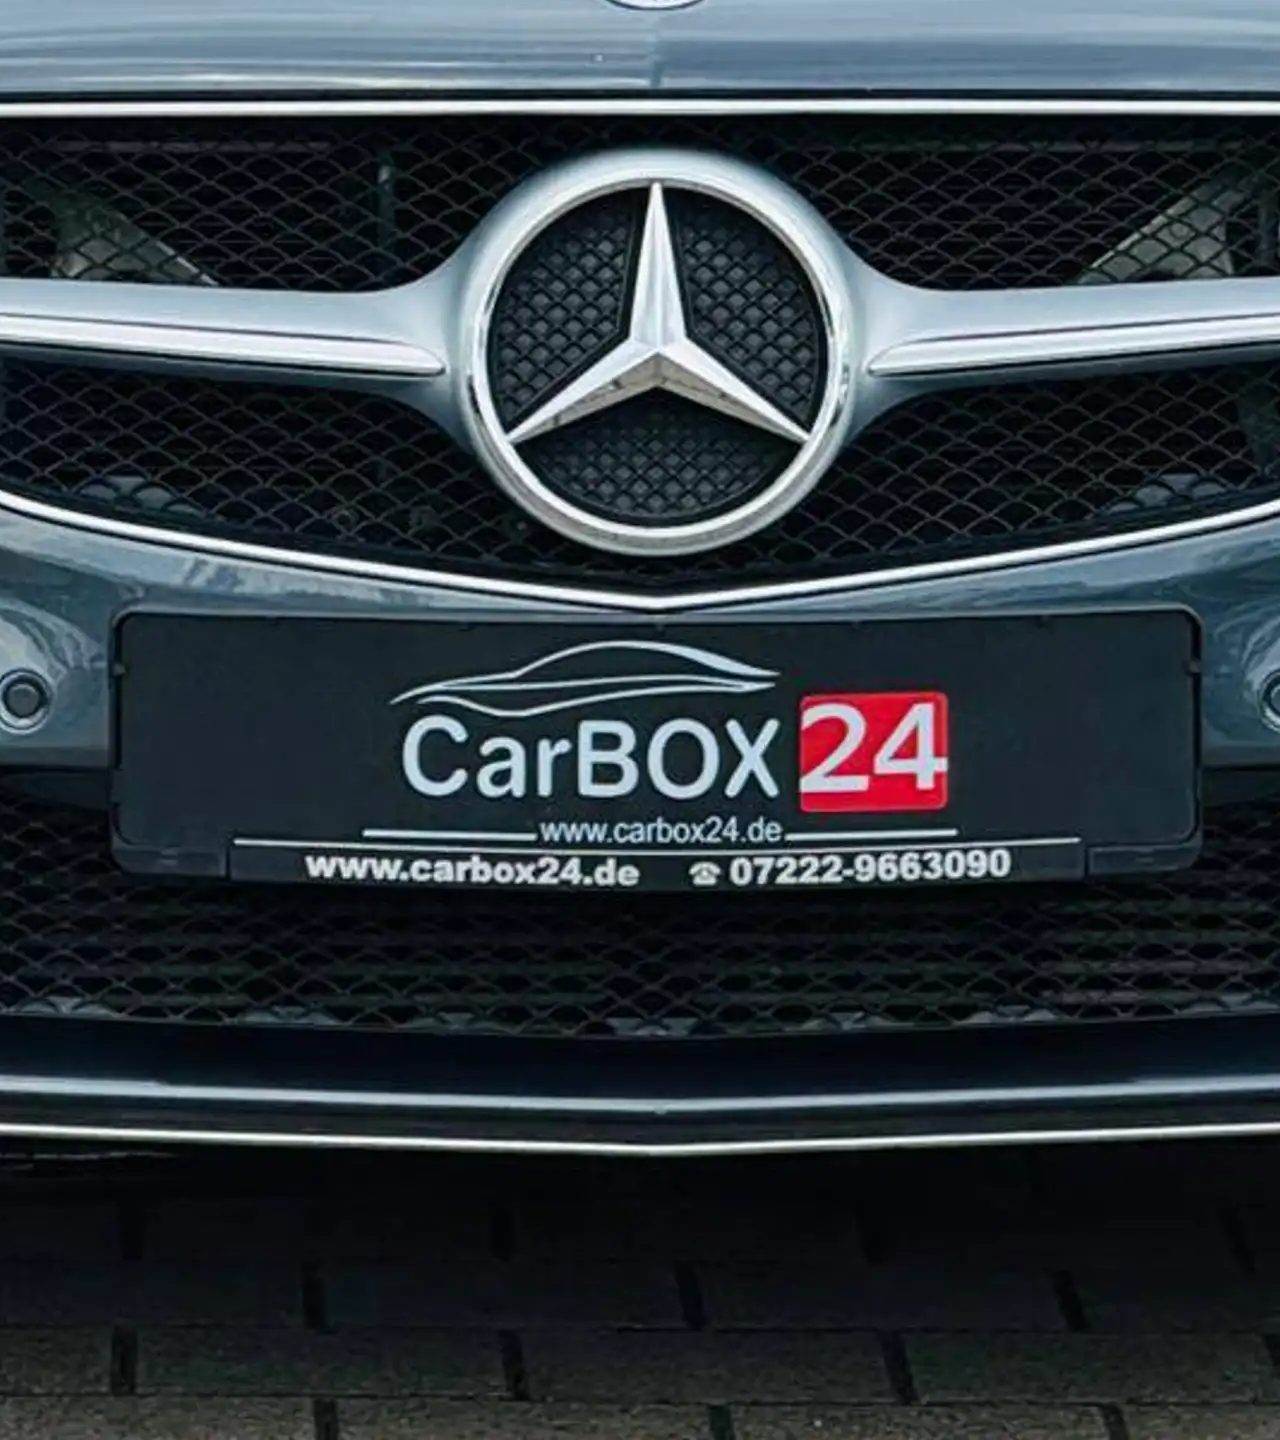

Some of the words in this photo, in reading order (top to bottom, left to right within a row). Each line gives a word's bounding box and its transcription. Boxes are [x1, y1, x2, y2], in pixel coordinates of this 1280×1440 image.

[539, 815, 783, 844] www.carbox24.de
[304, 854, 641, 887] www.carbox24.de
[729, 847, 1012, 886] 07222-9663090
